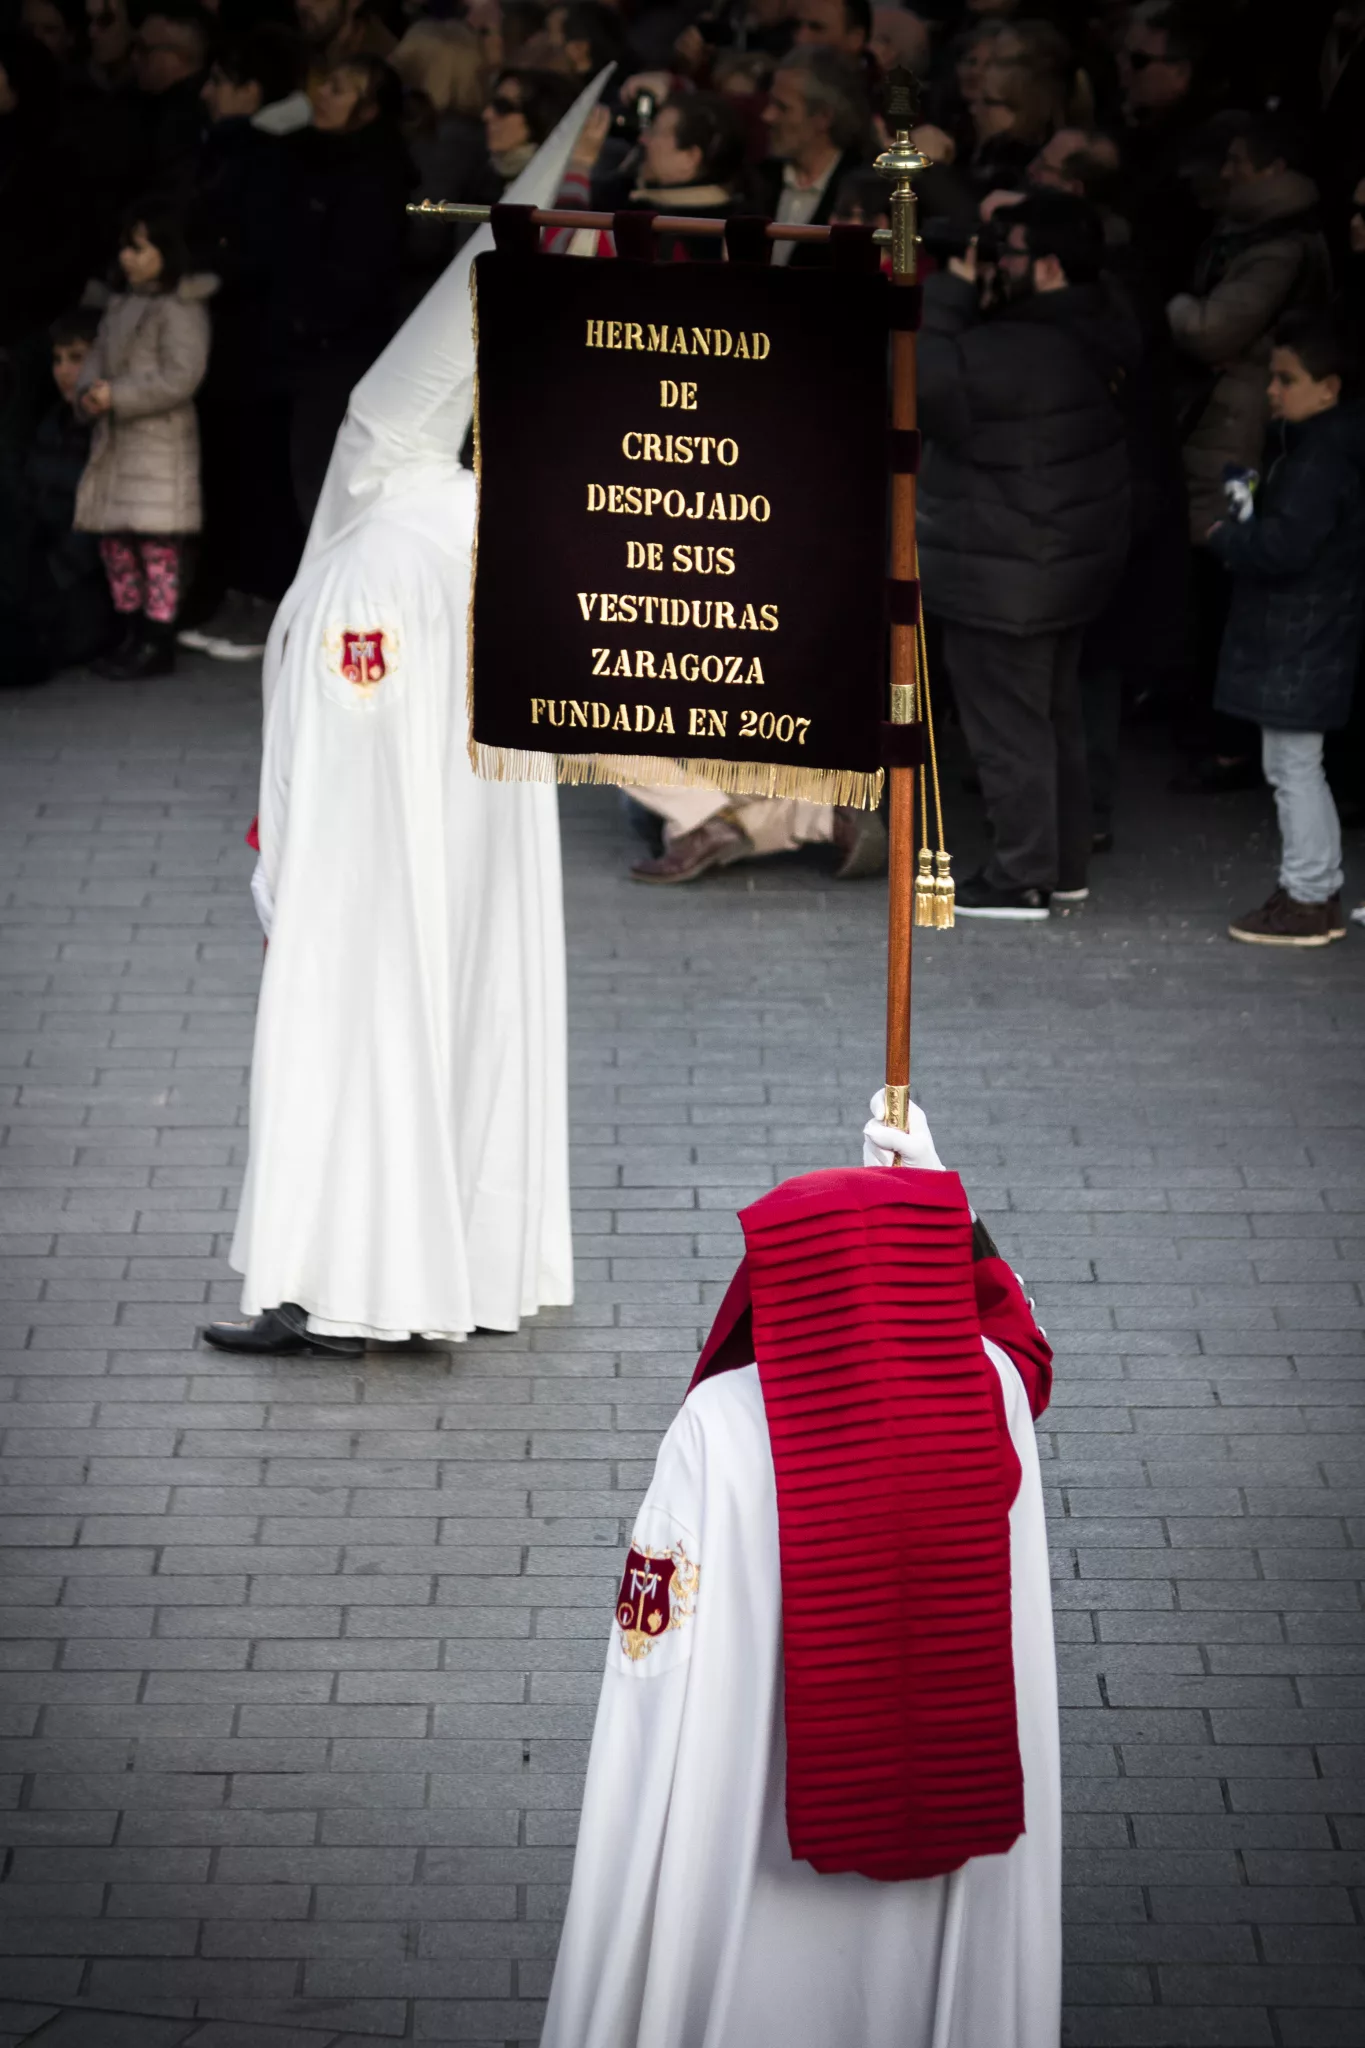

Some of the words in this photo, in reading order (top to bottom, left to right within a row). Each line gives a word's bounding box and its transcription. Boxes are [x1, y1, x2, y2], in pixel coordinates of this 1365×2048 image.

[585, 319, 771, 360] HERMANDAD
[659, 379, 698, 410] DE
[621, 431, 739, 466] CRISTO
[586, 483, 771, 522] DESPOJADO
[626, 540, 664, 572] DE
[672, 544, 736, 576] SUS
[577, 592, 780, 632] VESTIDURAS
[591, 647, 765, 685] ZARAGOZA
[530, 697, 676, 735] FUNDADA
[687, 707, 728, 738] EN
[738, 709, 812, 745] 2007
